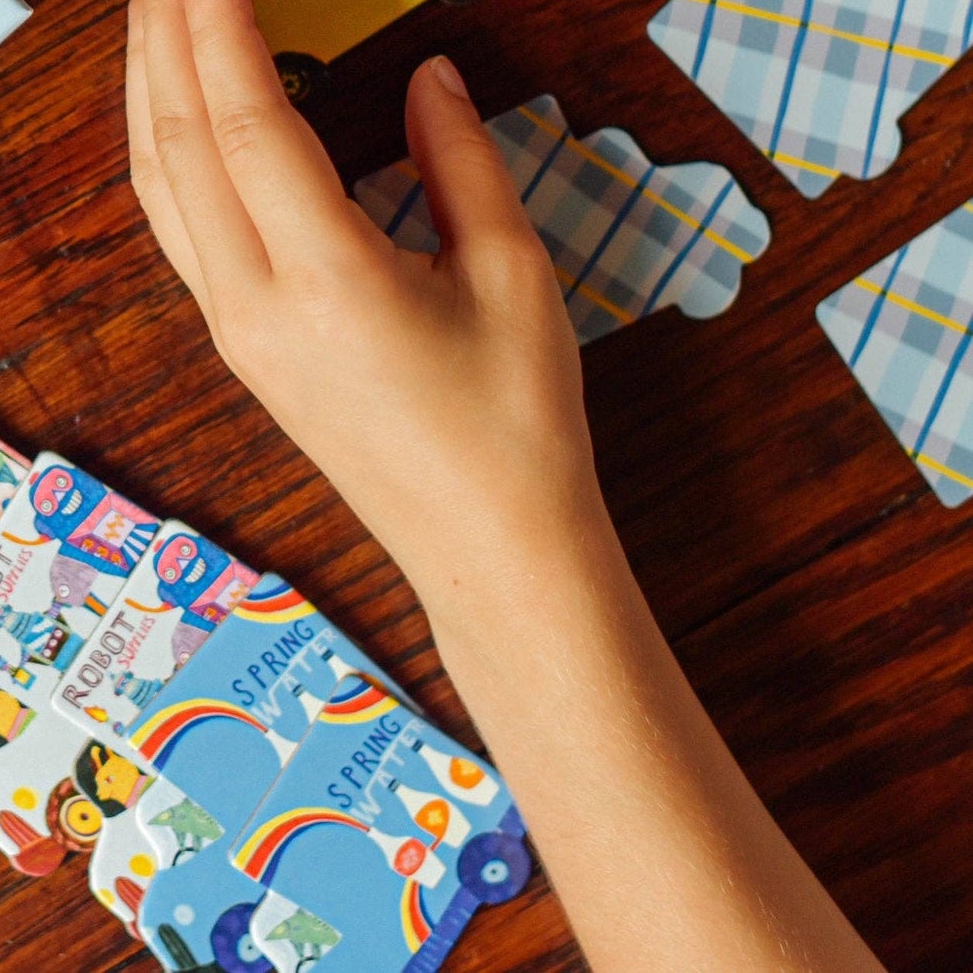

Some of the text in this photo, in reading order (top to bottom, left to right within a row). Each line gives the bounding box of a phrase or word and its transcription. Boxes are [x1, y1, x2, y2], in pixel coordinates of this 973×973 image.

[62, 611, 134, 709] ROBOT
[232, 619, 314, 706] SPRING
[251, 627, 337, 725] WATER
[328, 714, 401, 808] SPRING
[350, 718, 423, 824] WATER
